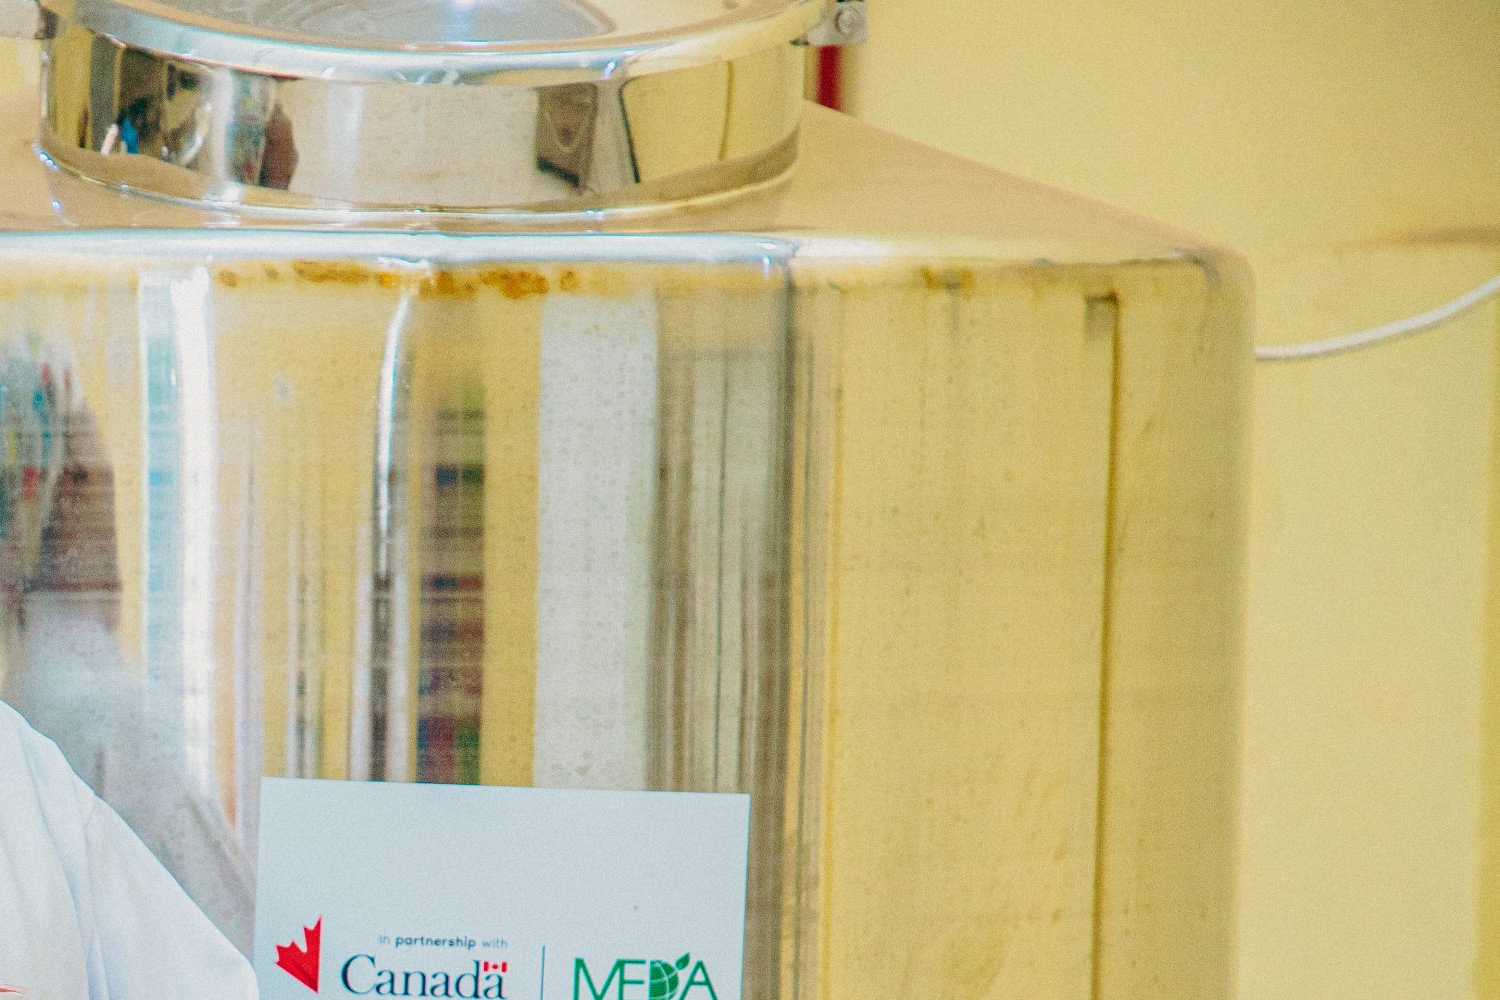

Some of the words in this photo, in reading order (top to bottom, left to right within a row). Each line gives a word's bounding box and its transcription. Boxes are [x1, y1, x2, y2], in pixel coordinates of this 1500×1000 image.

[379, 935, 390, 946] in
[395, 935, 477, 951] partnership
[482, 936, 508, 950] with
[341, 953, 508, 1000] Canada
